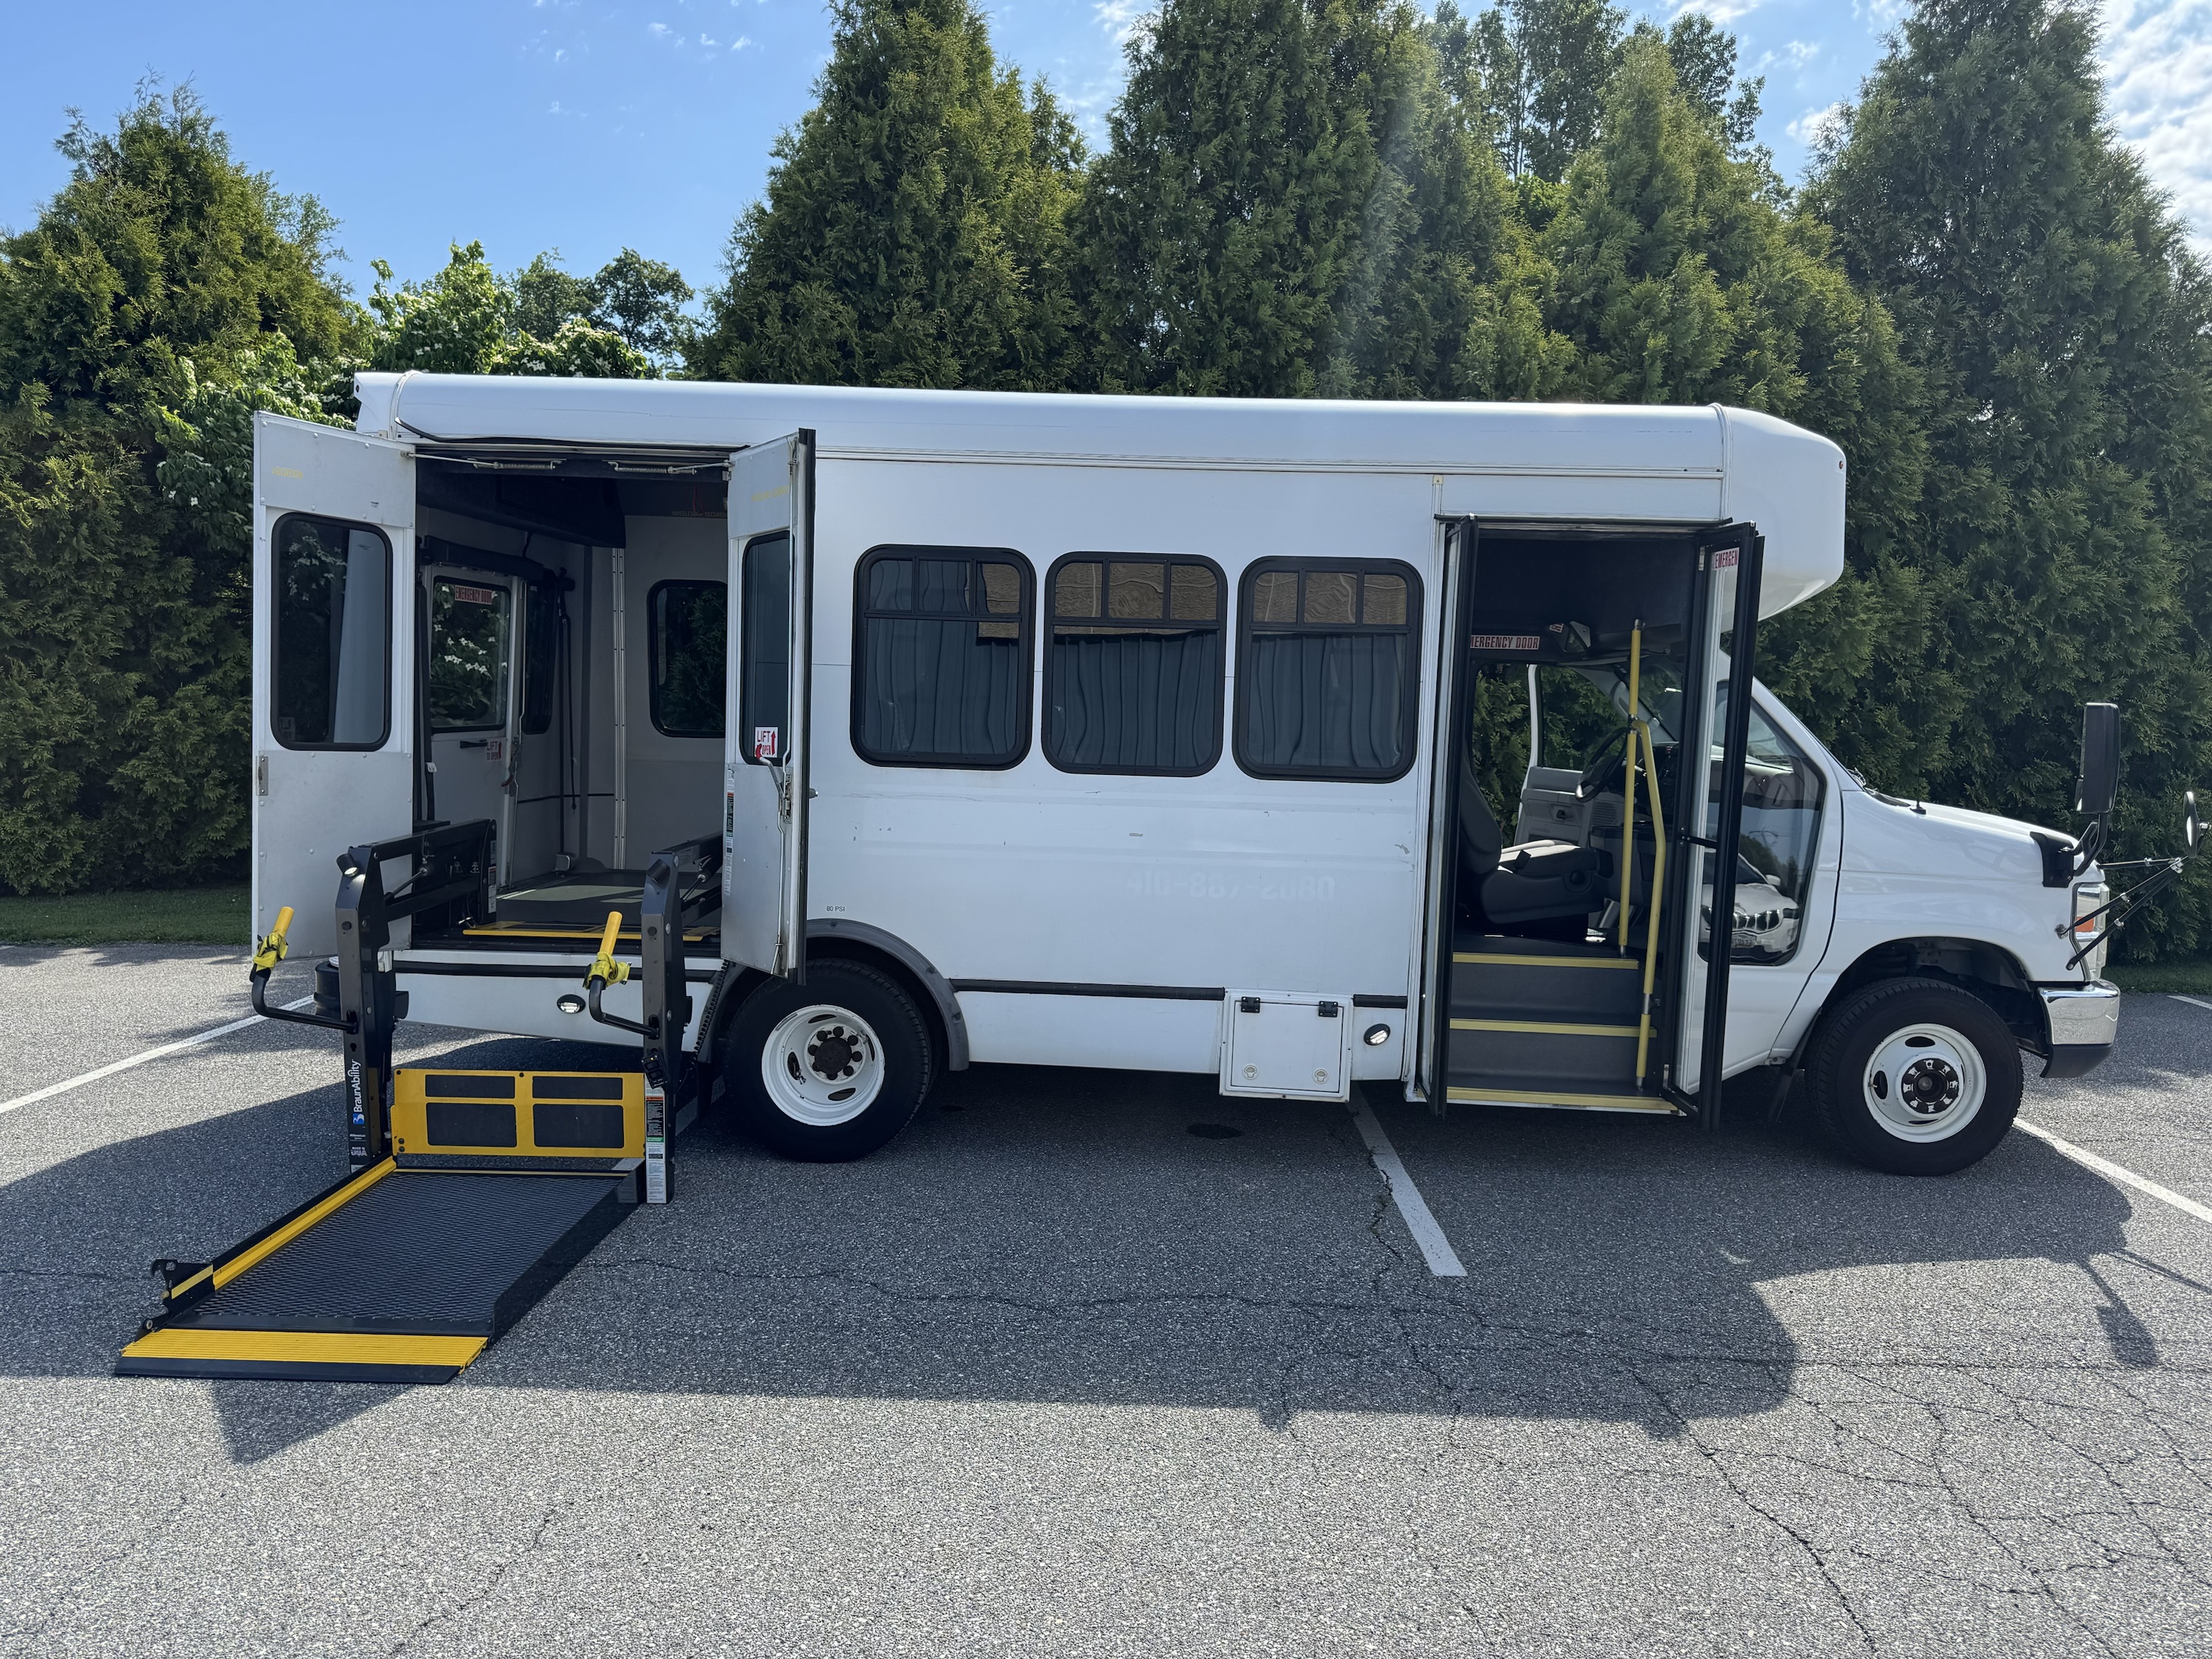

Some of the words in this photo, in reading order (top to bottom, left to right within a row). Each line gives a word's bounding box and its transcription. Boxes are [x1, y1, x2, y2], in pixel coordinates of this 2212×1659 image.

[1515, 637, 1539, 649] DOOR
[757, 731, 771, 742] LIFT
[347, 1060, 363, 1113] BraunAbility
